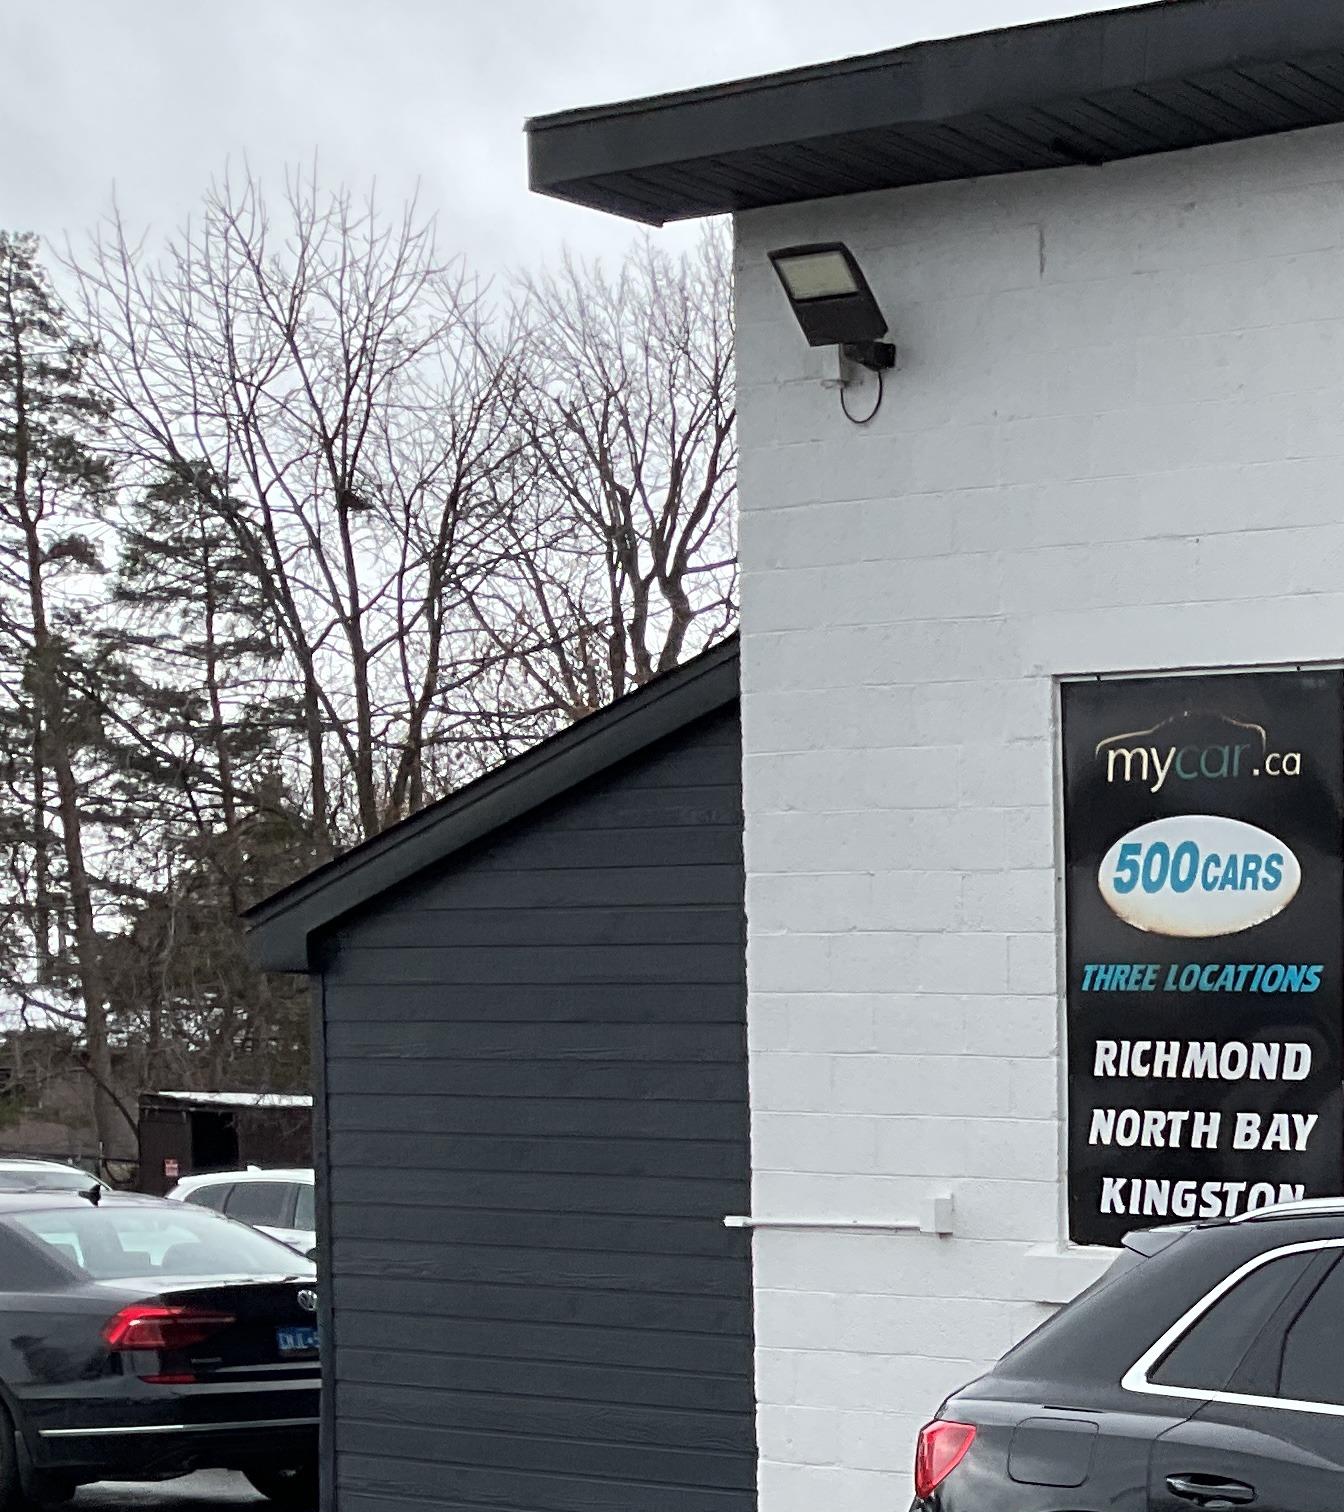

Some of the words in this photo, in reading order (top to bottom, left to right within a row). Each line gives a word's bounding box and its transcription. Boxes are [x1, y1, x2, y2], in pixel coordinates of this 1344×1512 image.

[1081, 964, 1160, 992] THREE
[1163, 963, 1325, 993] LOCATIONS
[1093, 1040, 1312, 1080] RICHMOND
[1088, 1109, 1221, 1149] NORTH
[1233, 1112, 1319, 1151] BAY
